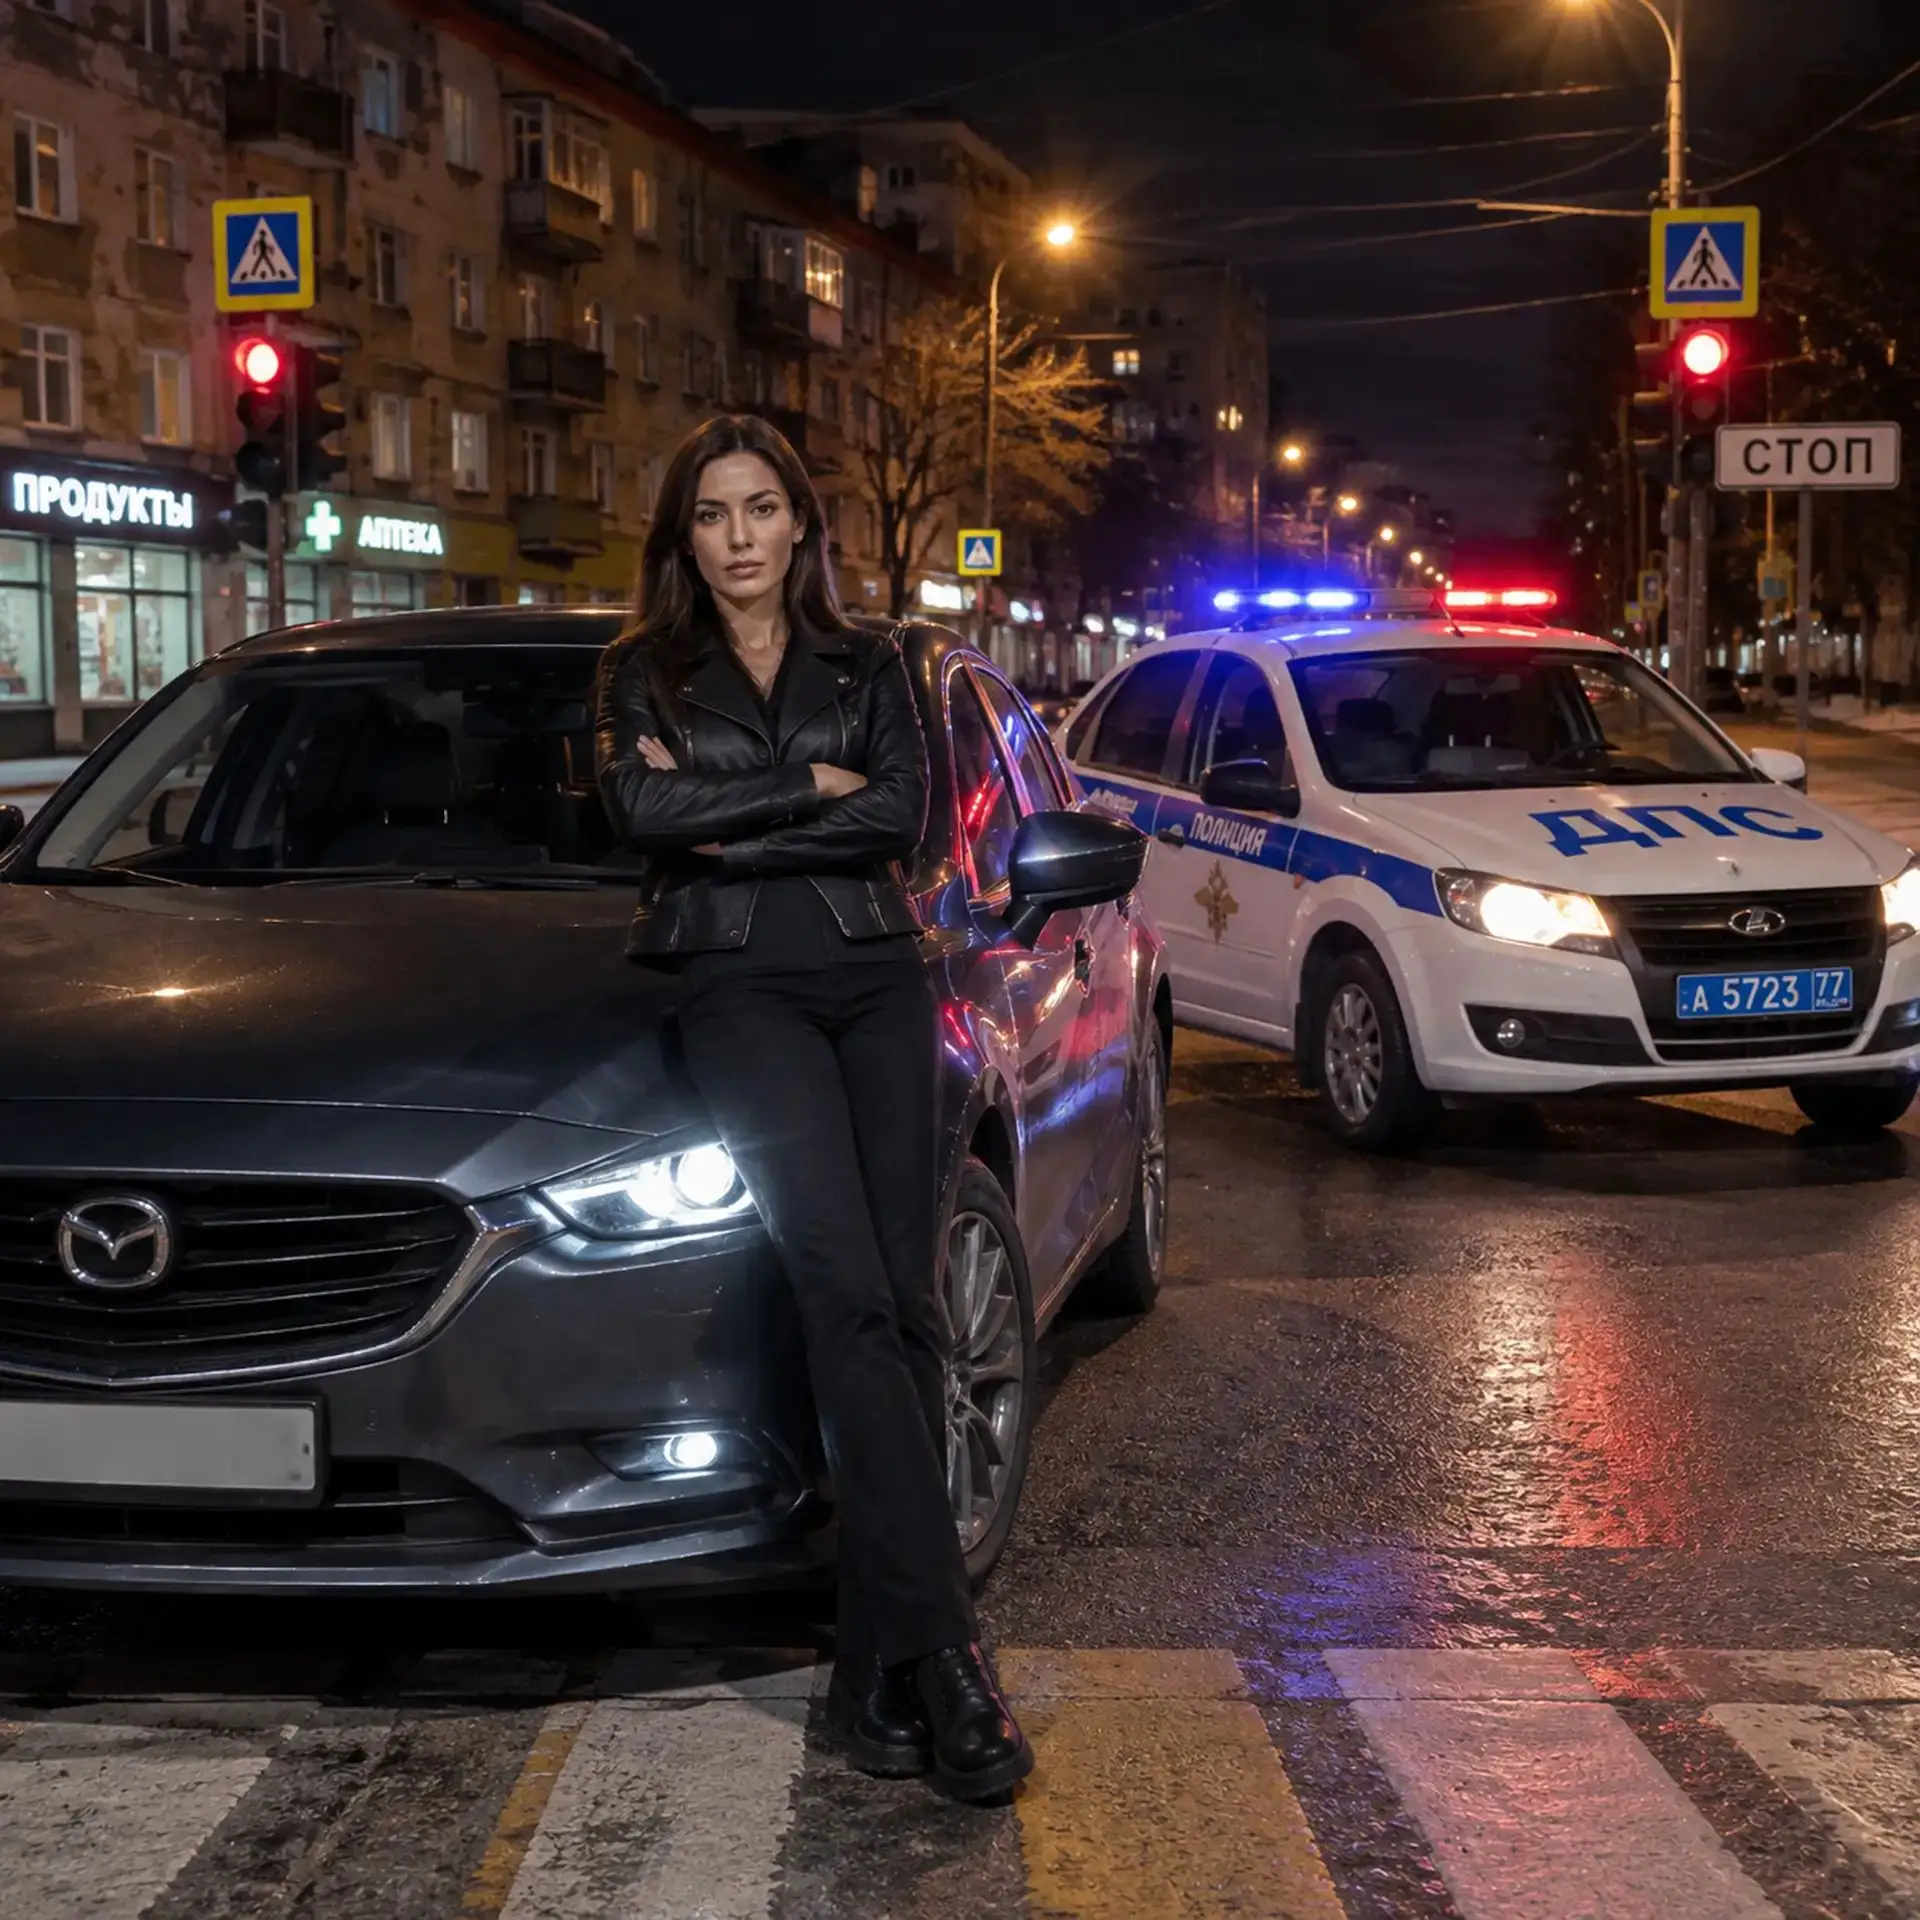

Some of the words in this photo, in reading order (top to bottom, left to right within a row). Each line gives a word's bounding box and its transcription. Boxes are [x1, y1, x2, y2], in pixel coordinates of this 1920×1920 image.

[1743, 437, 1872, 475] СТОП
[13, 472, 193, 529] ПРОДУКТЫ
[358, 515, 443, 555] АПТЕКА
[1188, 811, 1268, 857] ПОЛИЦИЯ
[1528, 805, 1824, 857] ДПС
[1723, 975, 1799, 1010] 5723
[1815, 971, 1844, 997] 77
